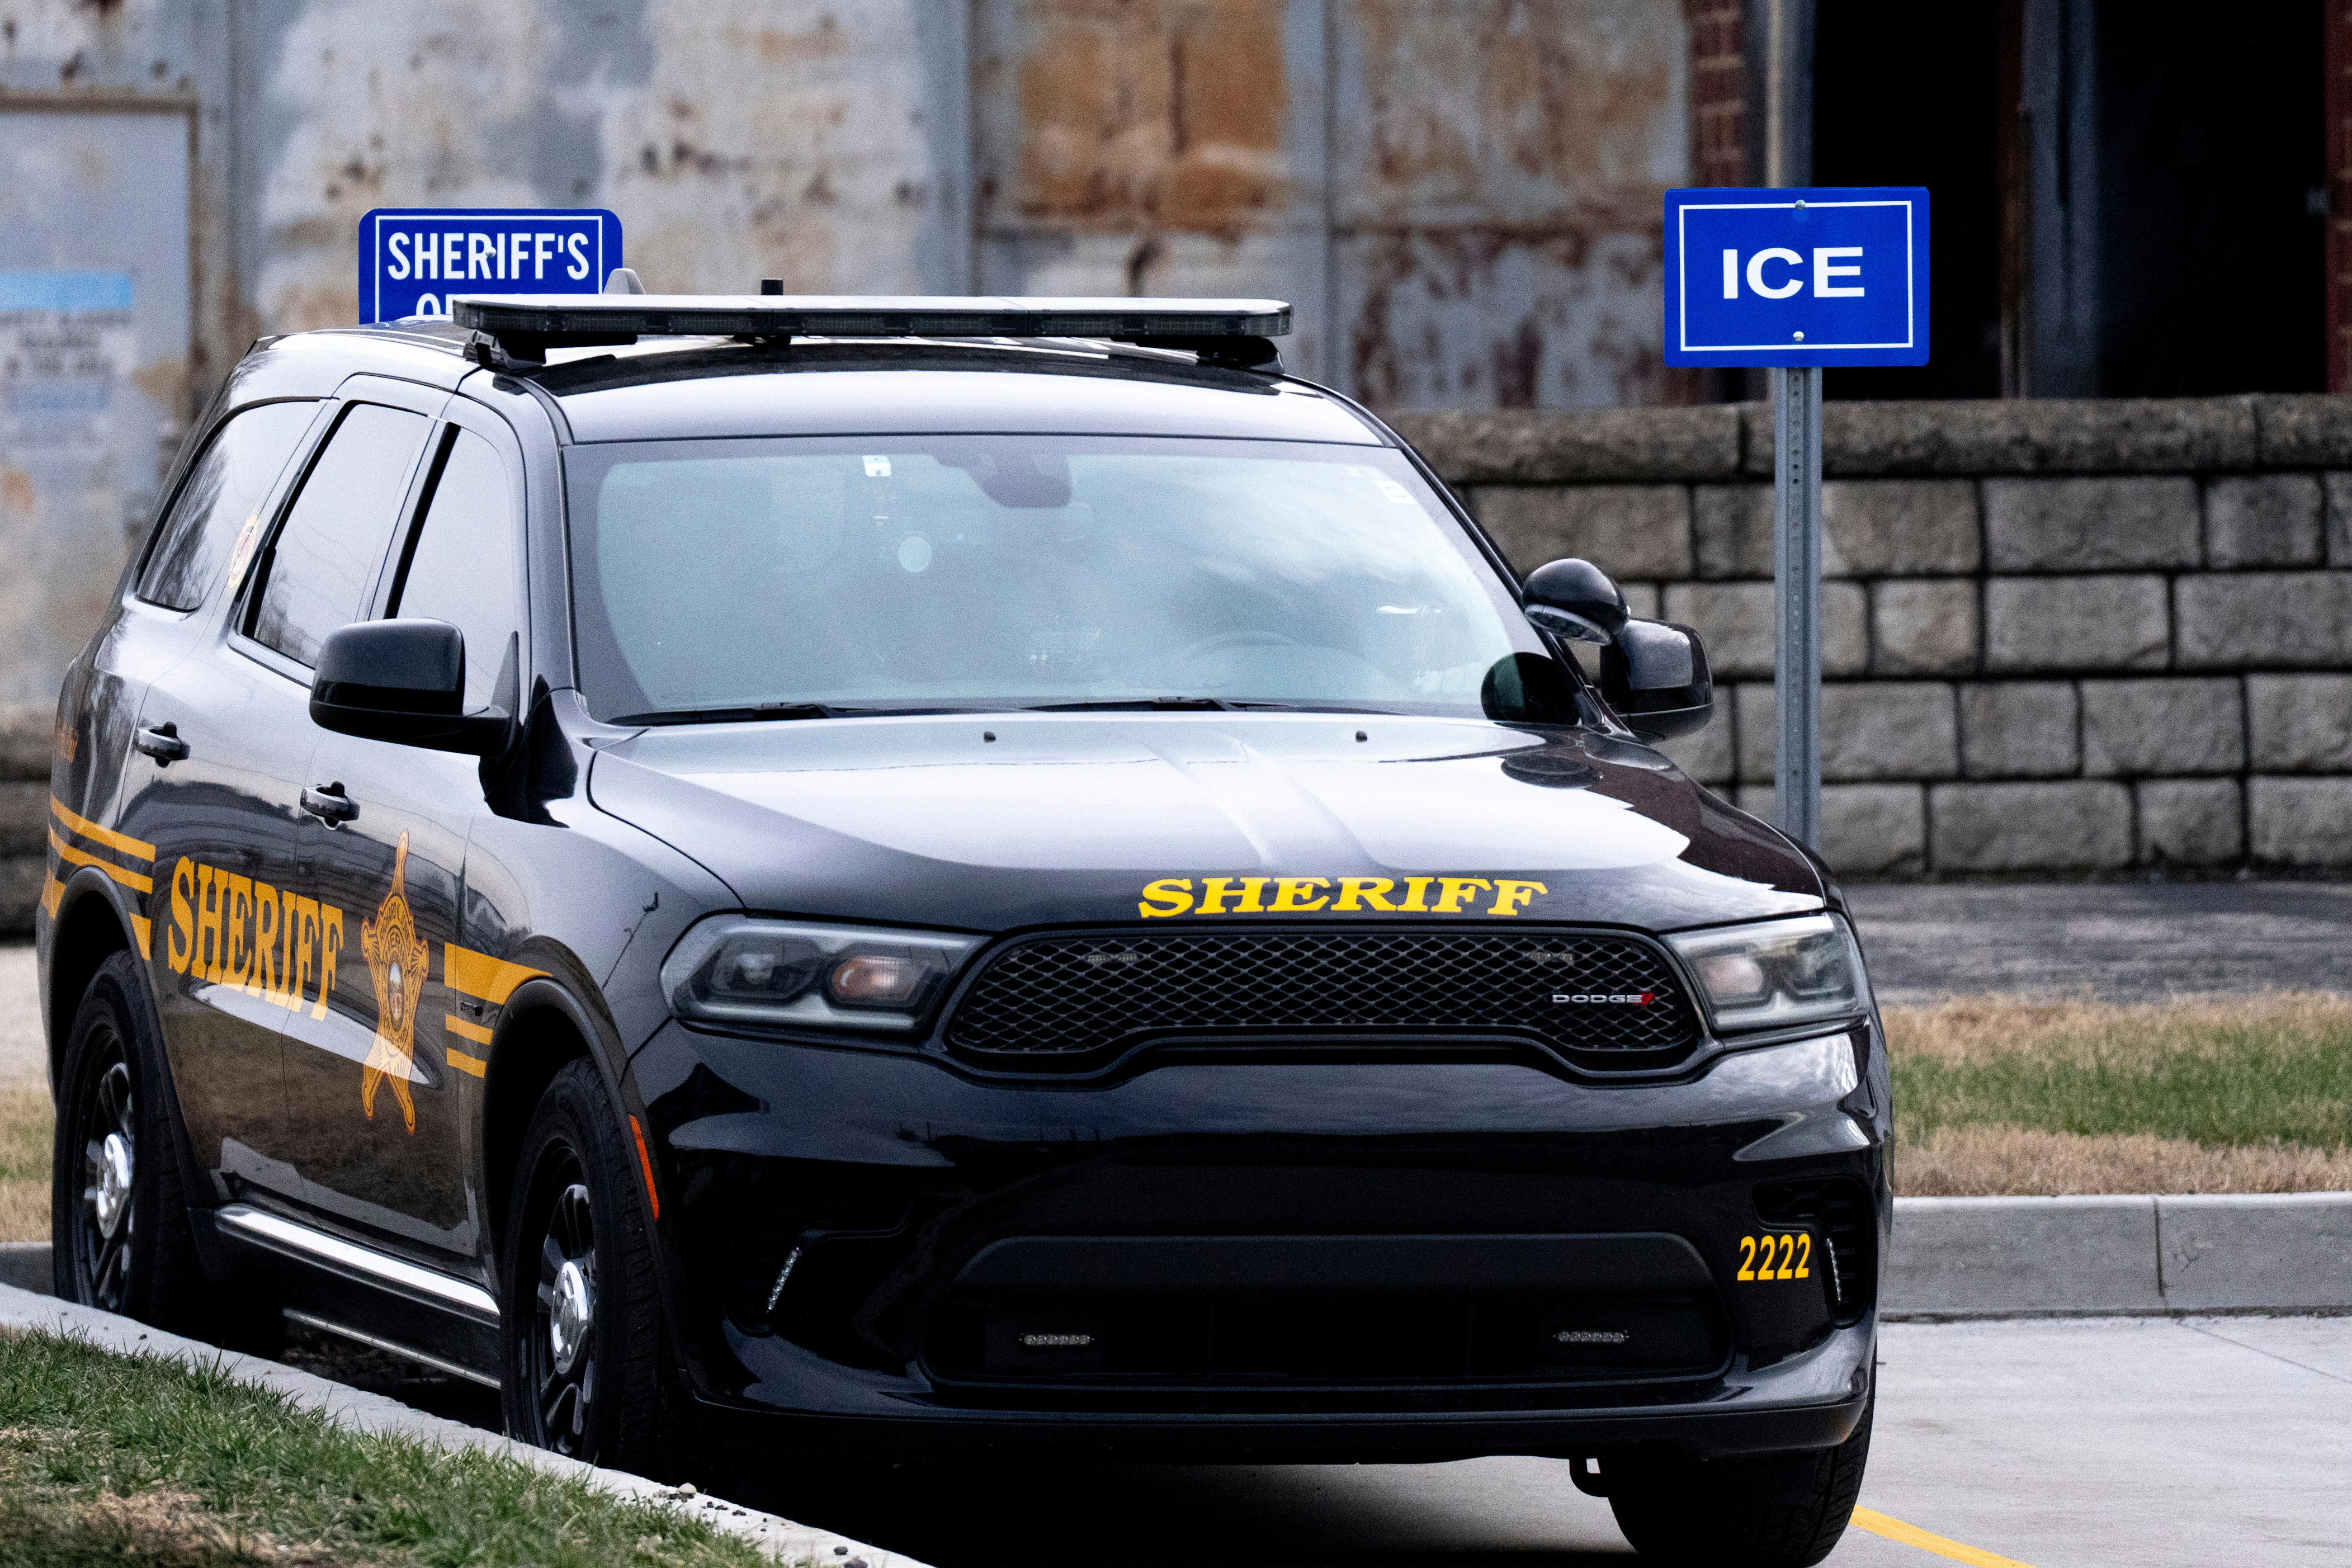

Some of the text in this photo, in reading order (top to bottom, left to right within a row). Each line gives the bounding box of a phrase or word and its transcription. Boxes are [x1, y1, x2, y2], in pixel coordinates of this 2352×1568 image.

[388, 233, 589, 280] SHERIFF'S
[1723, 247, 1864, 299] ICE
[1139, 877, 1547, 918] SHERIFF
[168, 856, 344, 1021] SHERIFF
[1552, 994, 1642, 1003] DODGE
[1737, 1233, 1811, 1281] 2222
